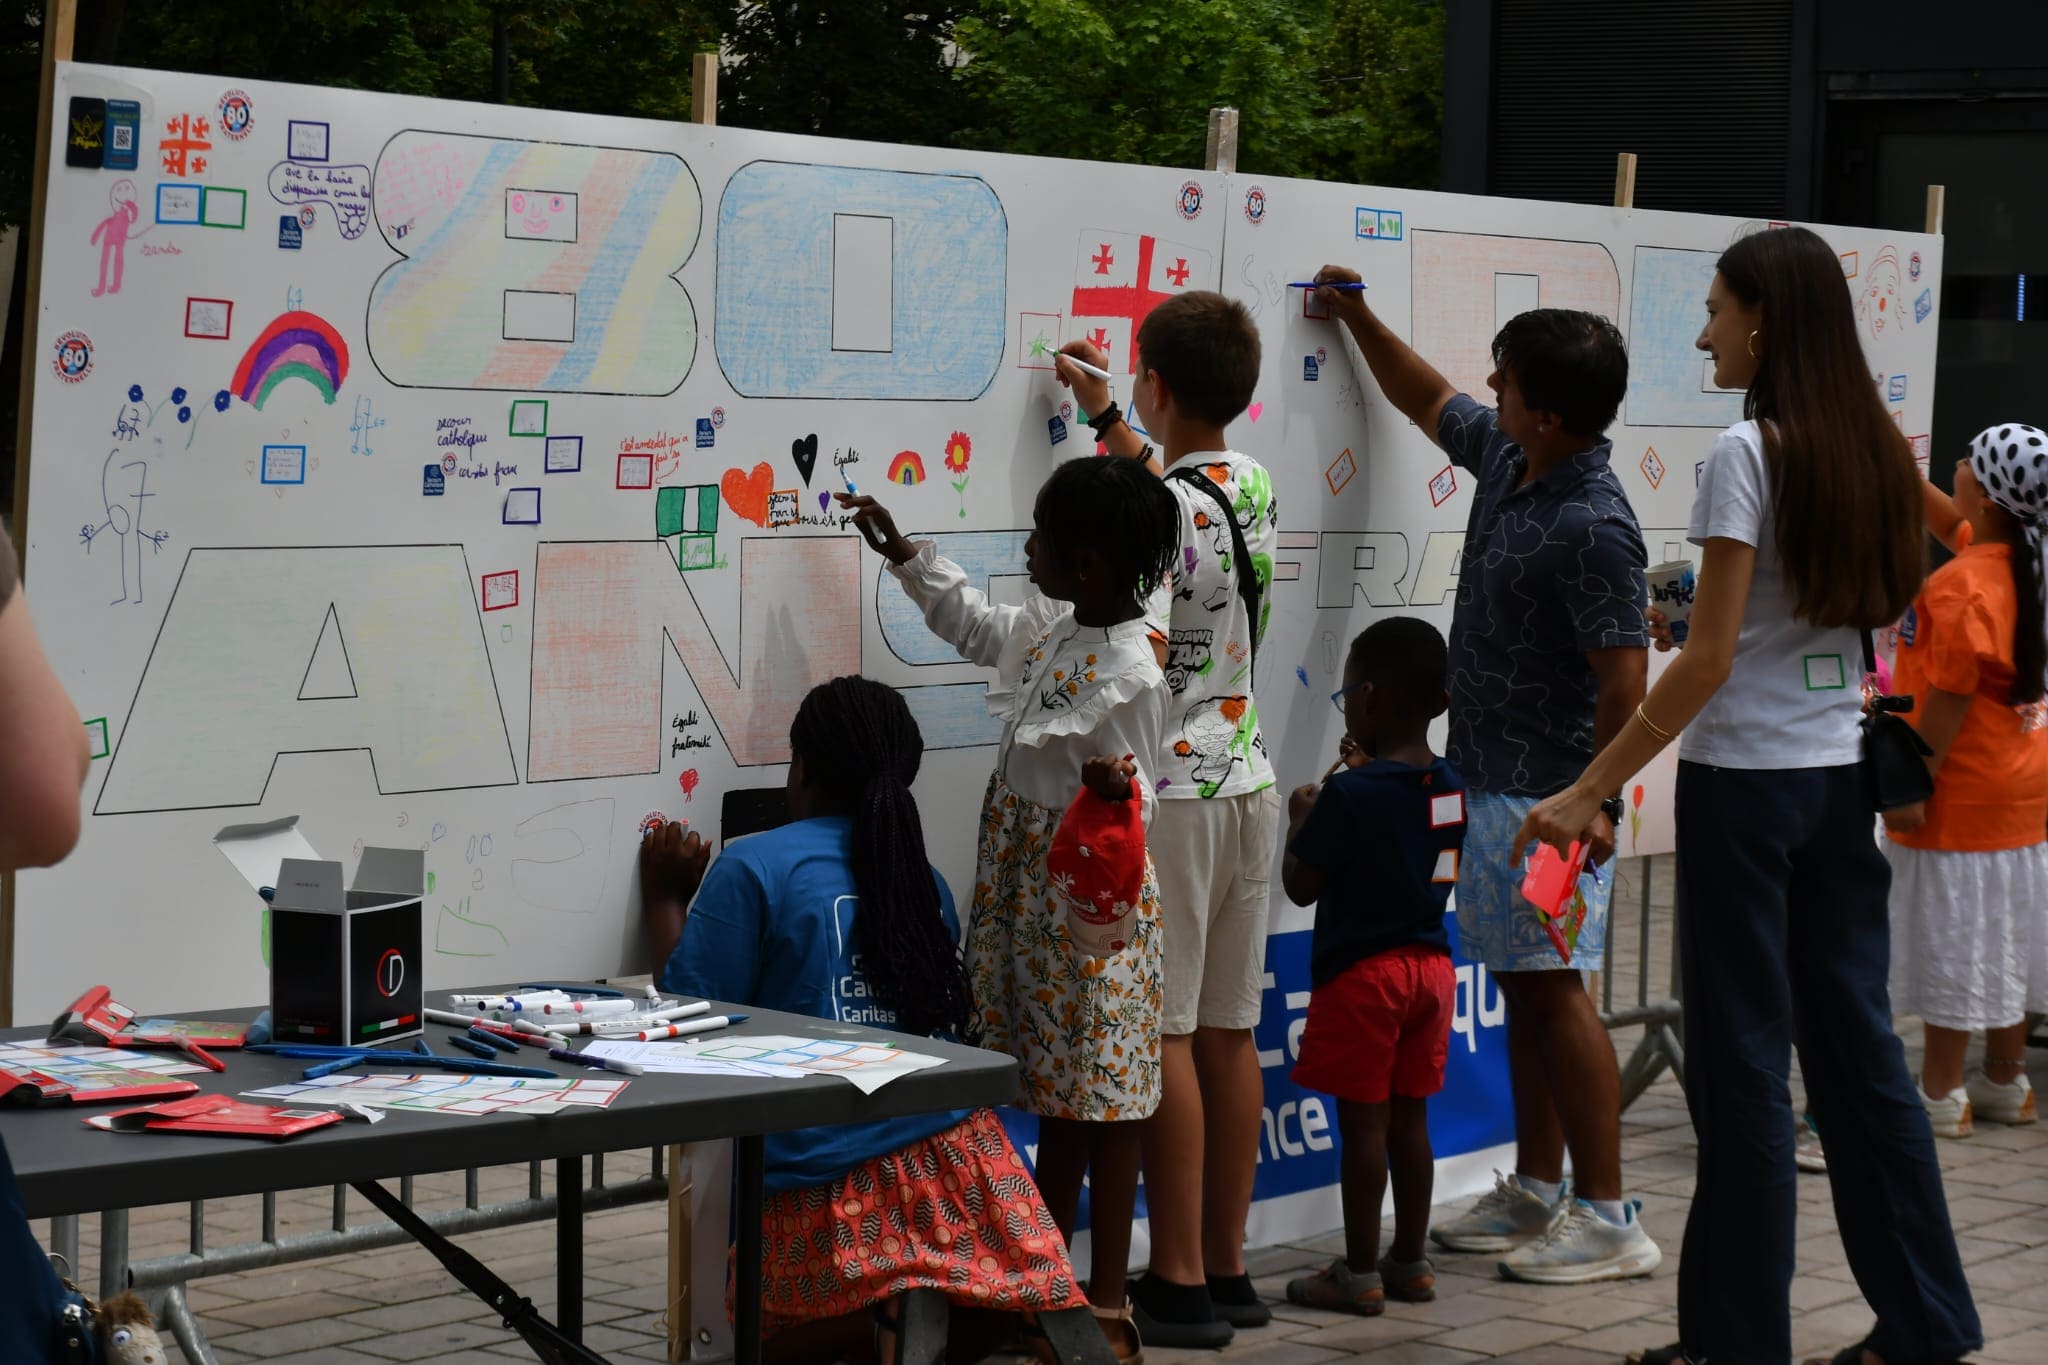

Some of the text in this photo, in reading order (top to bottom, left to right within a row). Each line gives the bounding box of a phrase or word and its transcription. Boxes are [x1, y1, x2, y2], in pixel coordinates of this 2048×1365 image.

[226, 105, 246, 124] 80
[1183, 192, 1198, 209] 80
[1249, 197, 1263, 214] 80
[366, 129, 1008, 401] 80
[63, 348, 86, 368] 80
[1168, 629, 1214, 644] RAWL
[841, 1005, 897, 1024] Caritas
